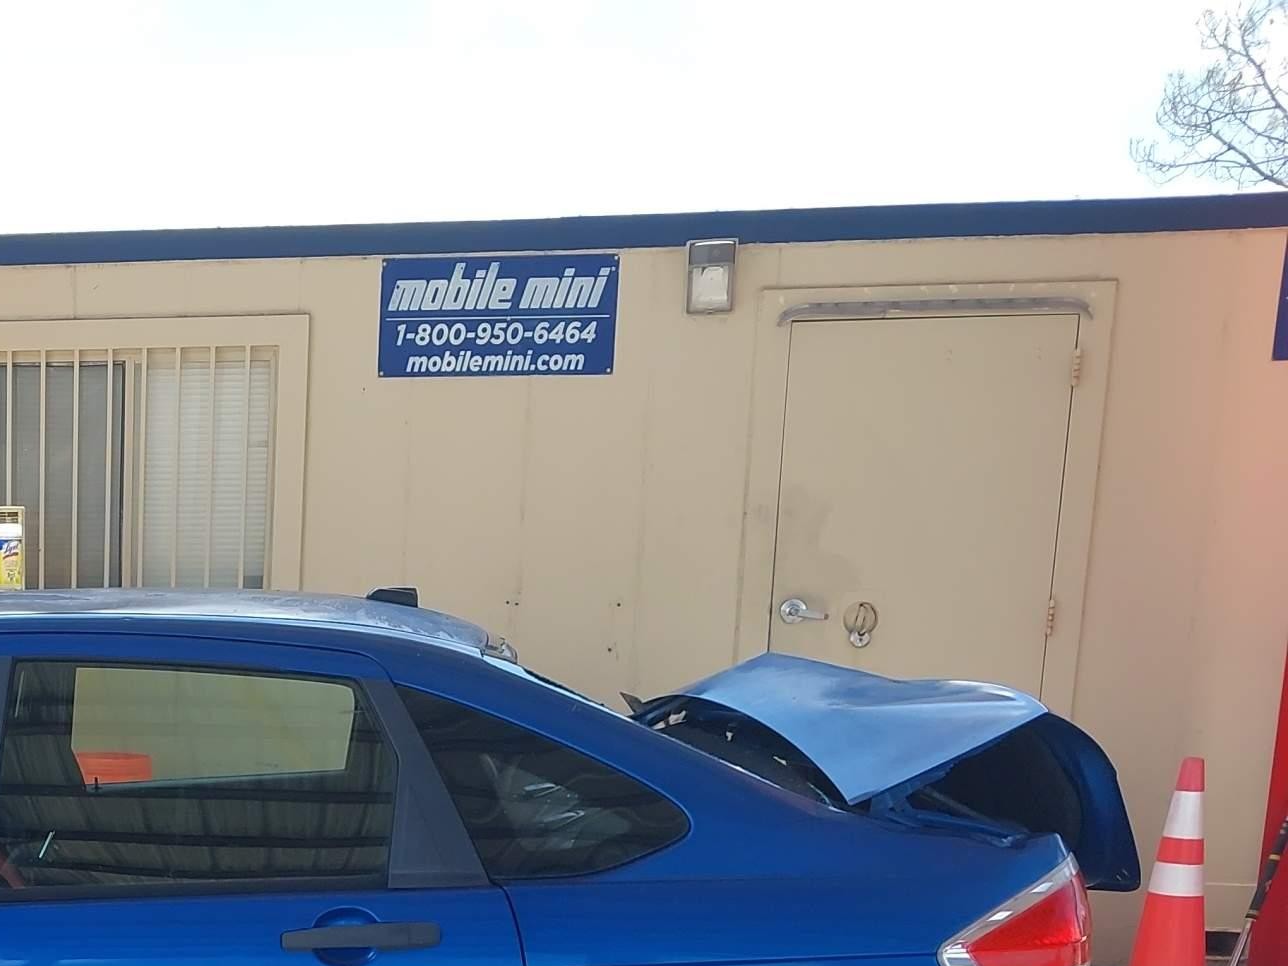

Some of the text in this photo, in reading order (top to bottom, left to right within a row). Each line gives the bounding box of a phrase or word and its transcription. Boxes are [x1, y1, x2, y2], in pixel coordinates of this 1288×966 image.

[387, 262, 611, 312] mobile mini
[396, 321, 597, 346] 1-800-950-6464
[406, 350, 585, 374] mobilemini.com
